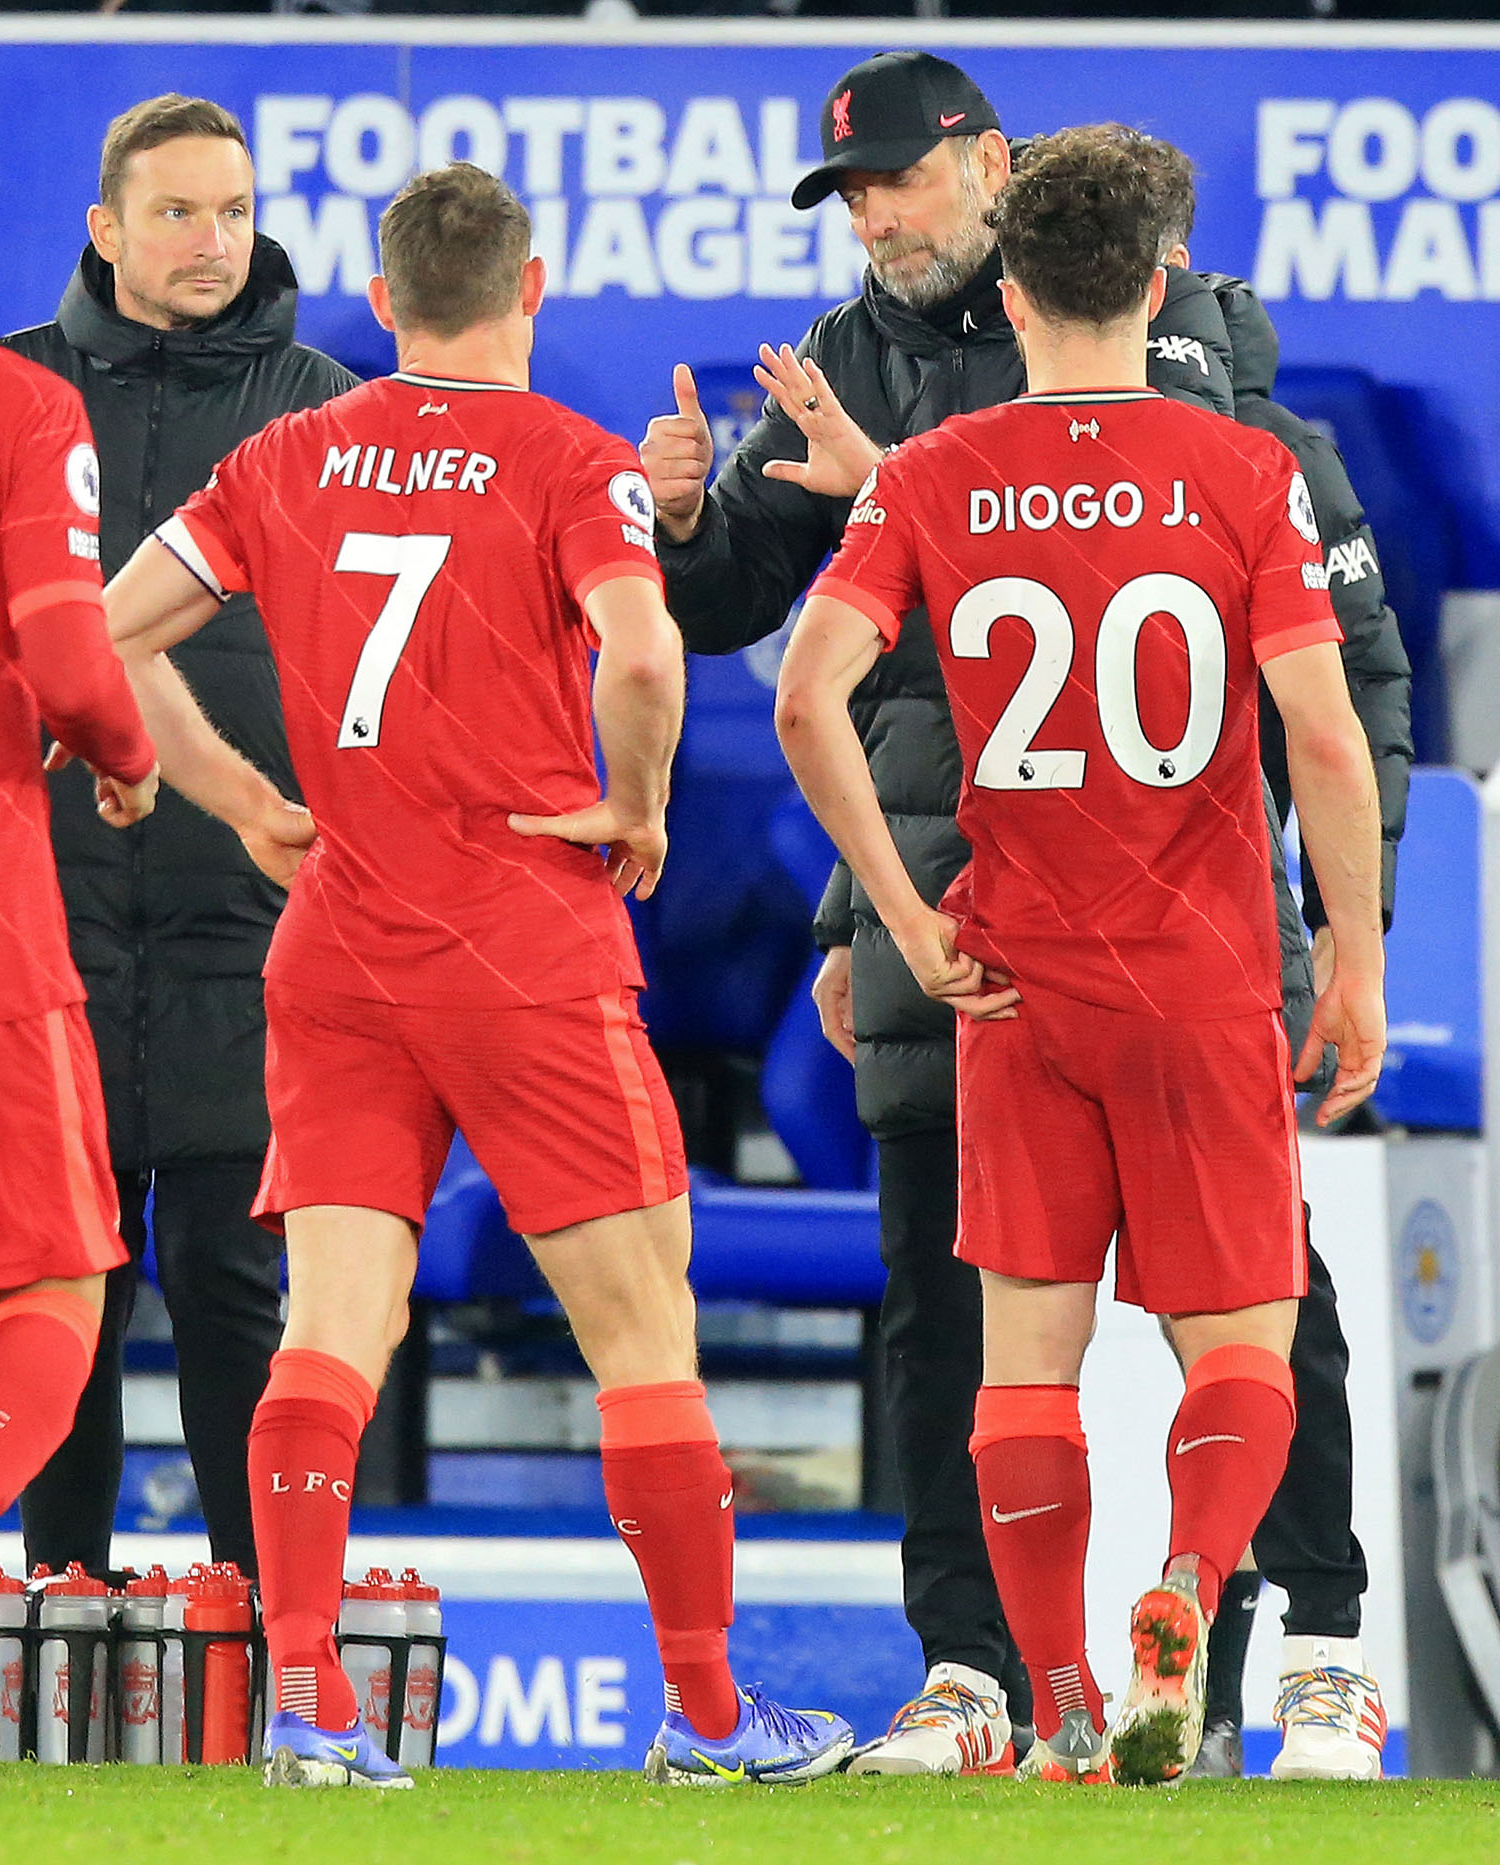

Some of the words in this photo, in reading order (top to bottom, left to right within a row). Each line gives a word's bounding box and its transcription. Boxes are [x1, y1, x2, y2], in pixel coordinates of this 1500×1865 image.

[1253, 199, 1500, 300] MA
[318, 446, 497, 495] MILNER
[969, 481, 1144, 534] DIOGO
[1161, 480, 1201, 527] J.
[1325, 537, 1379, 585] AXA
[334, 534, 452, 748] 7
[950, 572, 1227, 790] 20
[271, 1471, 350, 1502] LFC
